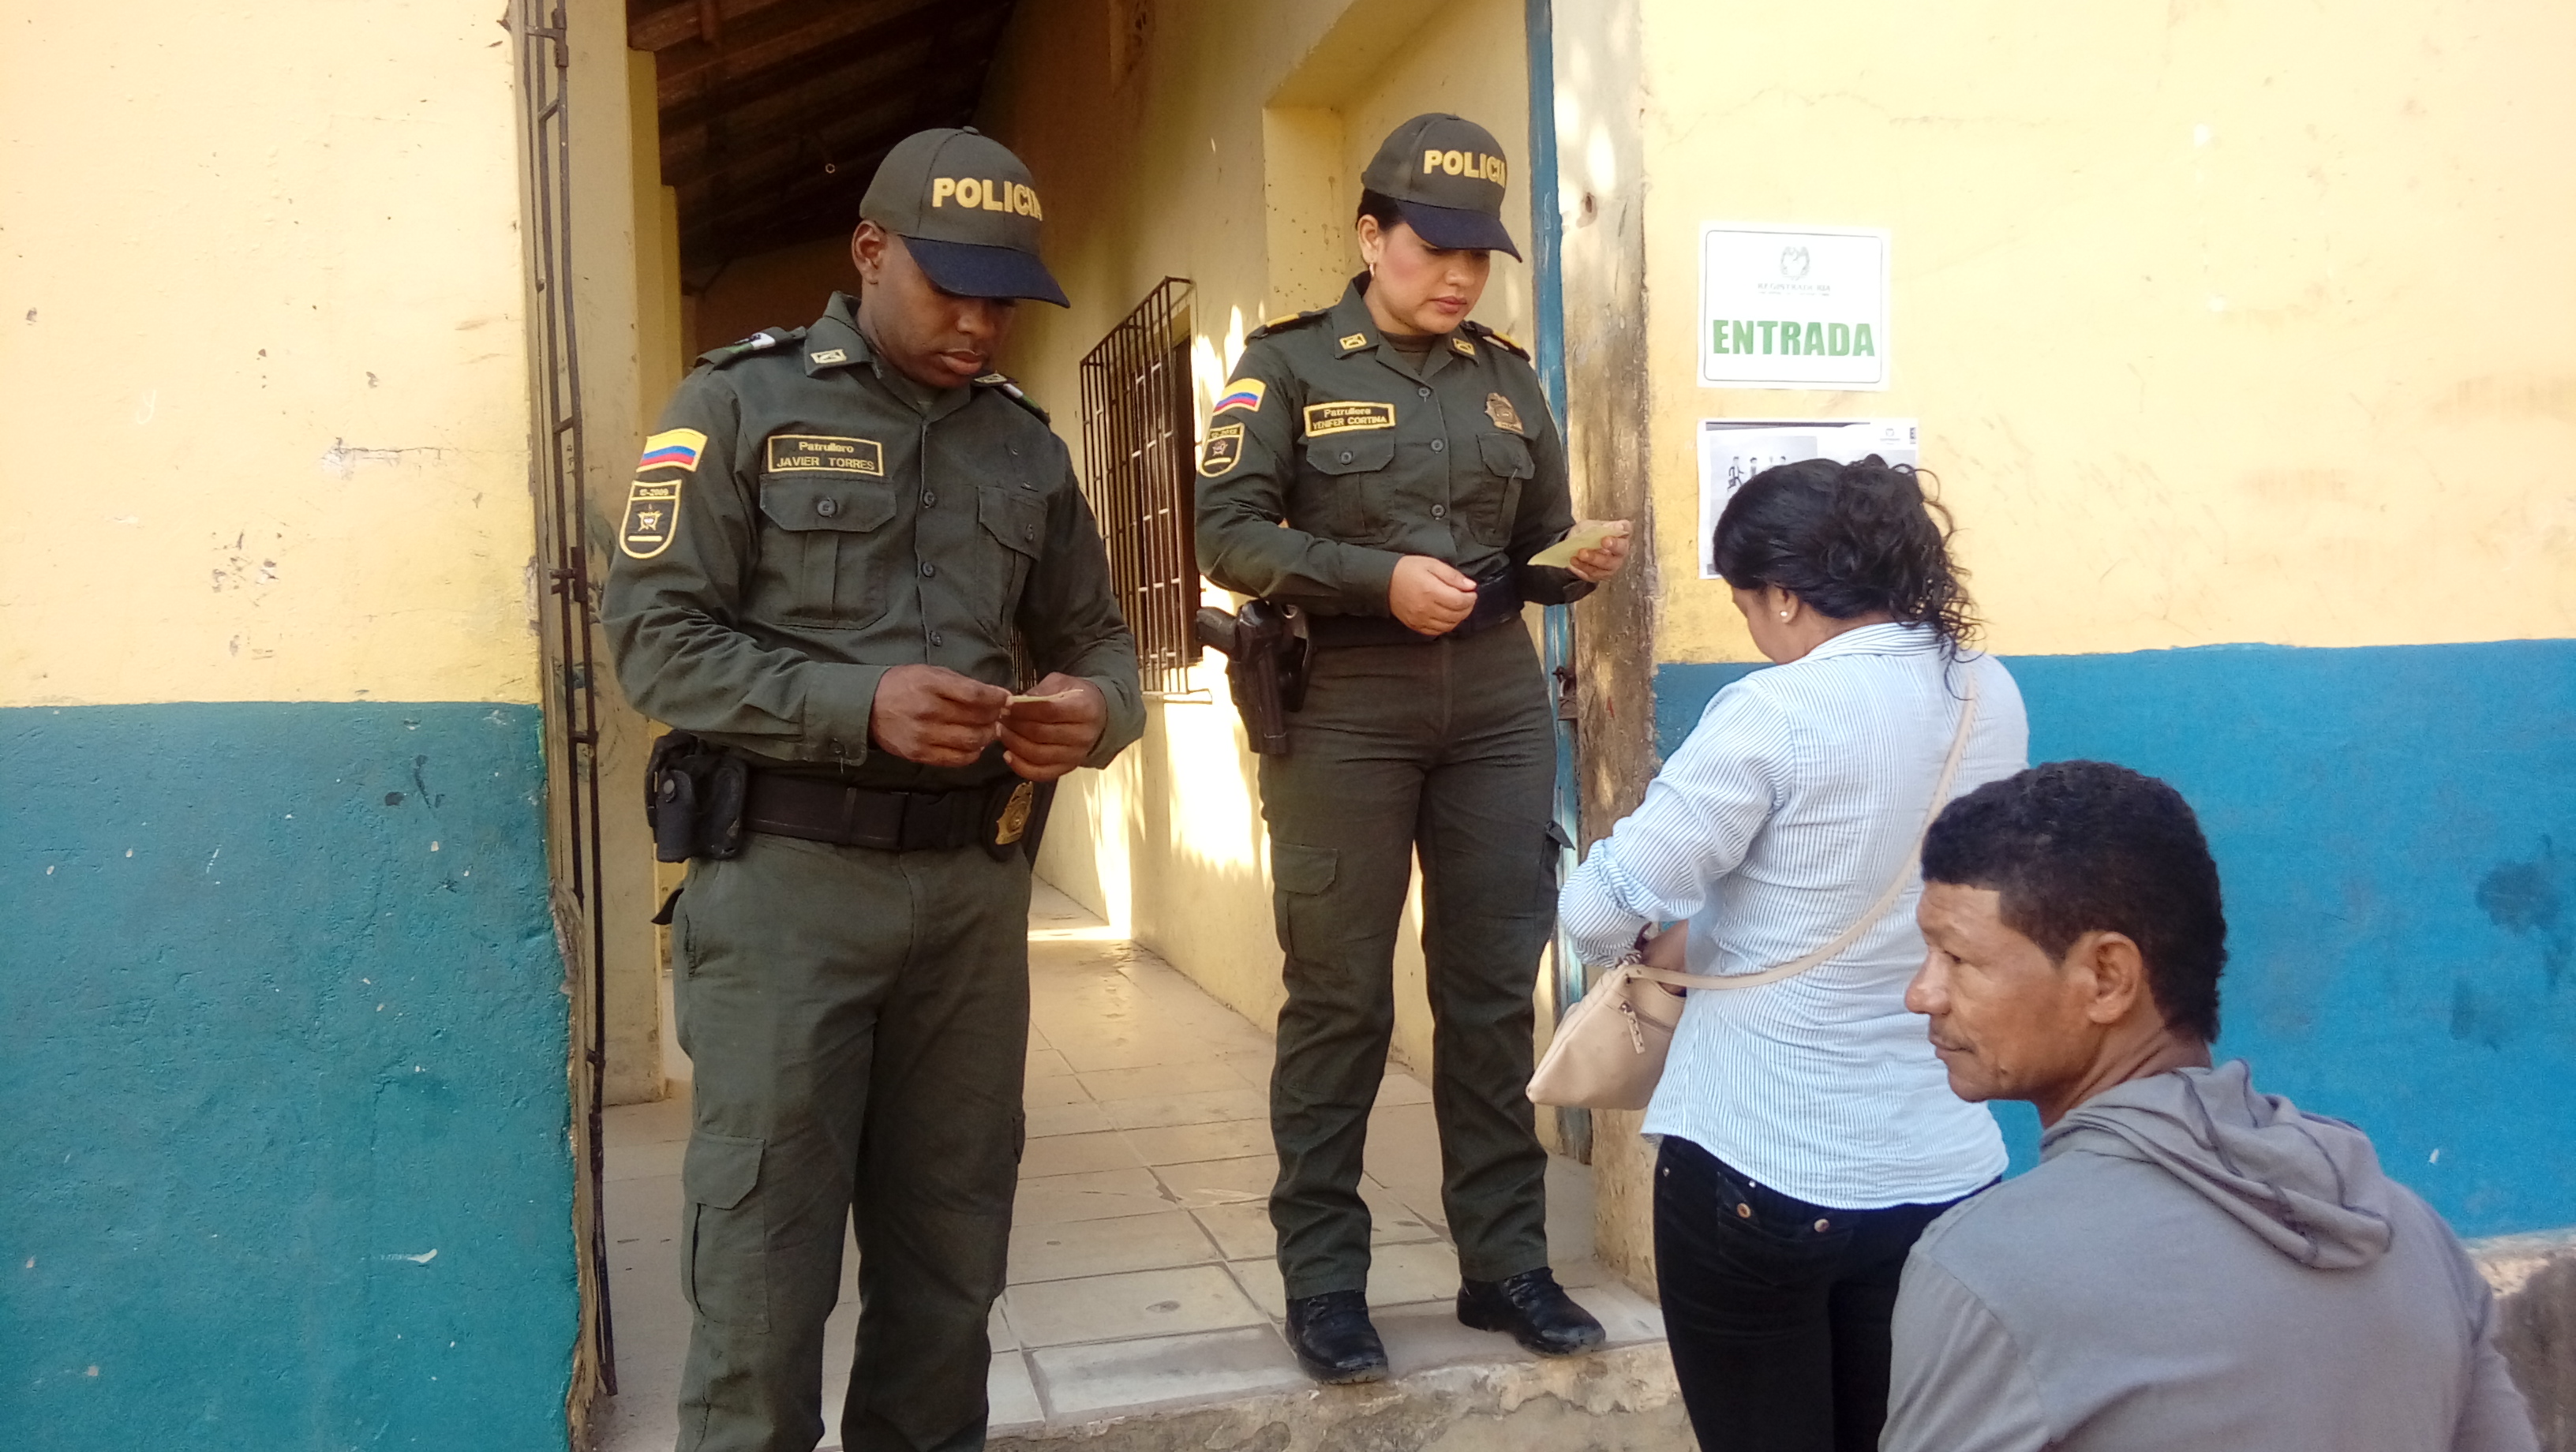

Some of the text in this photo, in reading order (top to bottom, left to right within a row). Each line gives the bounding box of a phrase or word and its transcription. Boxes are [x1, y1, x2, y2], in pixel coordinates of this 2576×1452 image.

[932, 177, 1043, 222] POLICIA
[1713, 319, 1875, 357] ENTRADA
[1346, 415, 1387, 425] CORTINA
[799, 441, 855, 453] Patrullero
[777, 456, 875, 471] JAVIER TORRES
